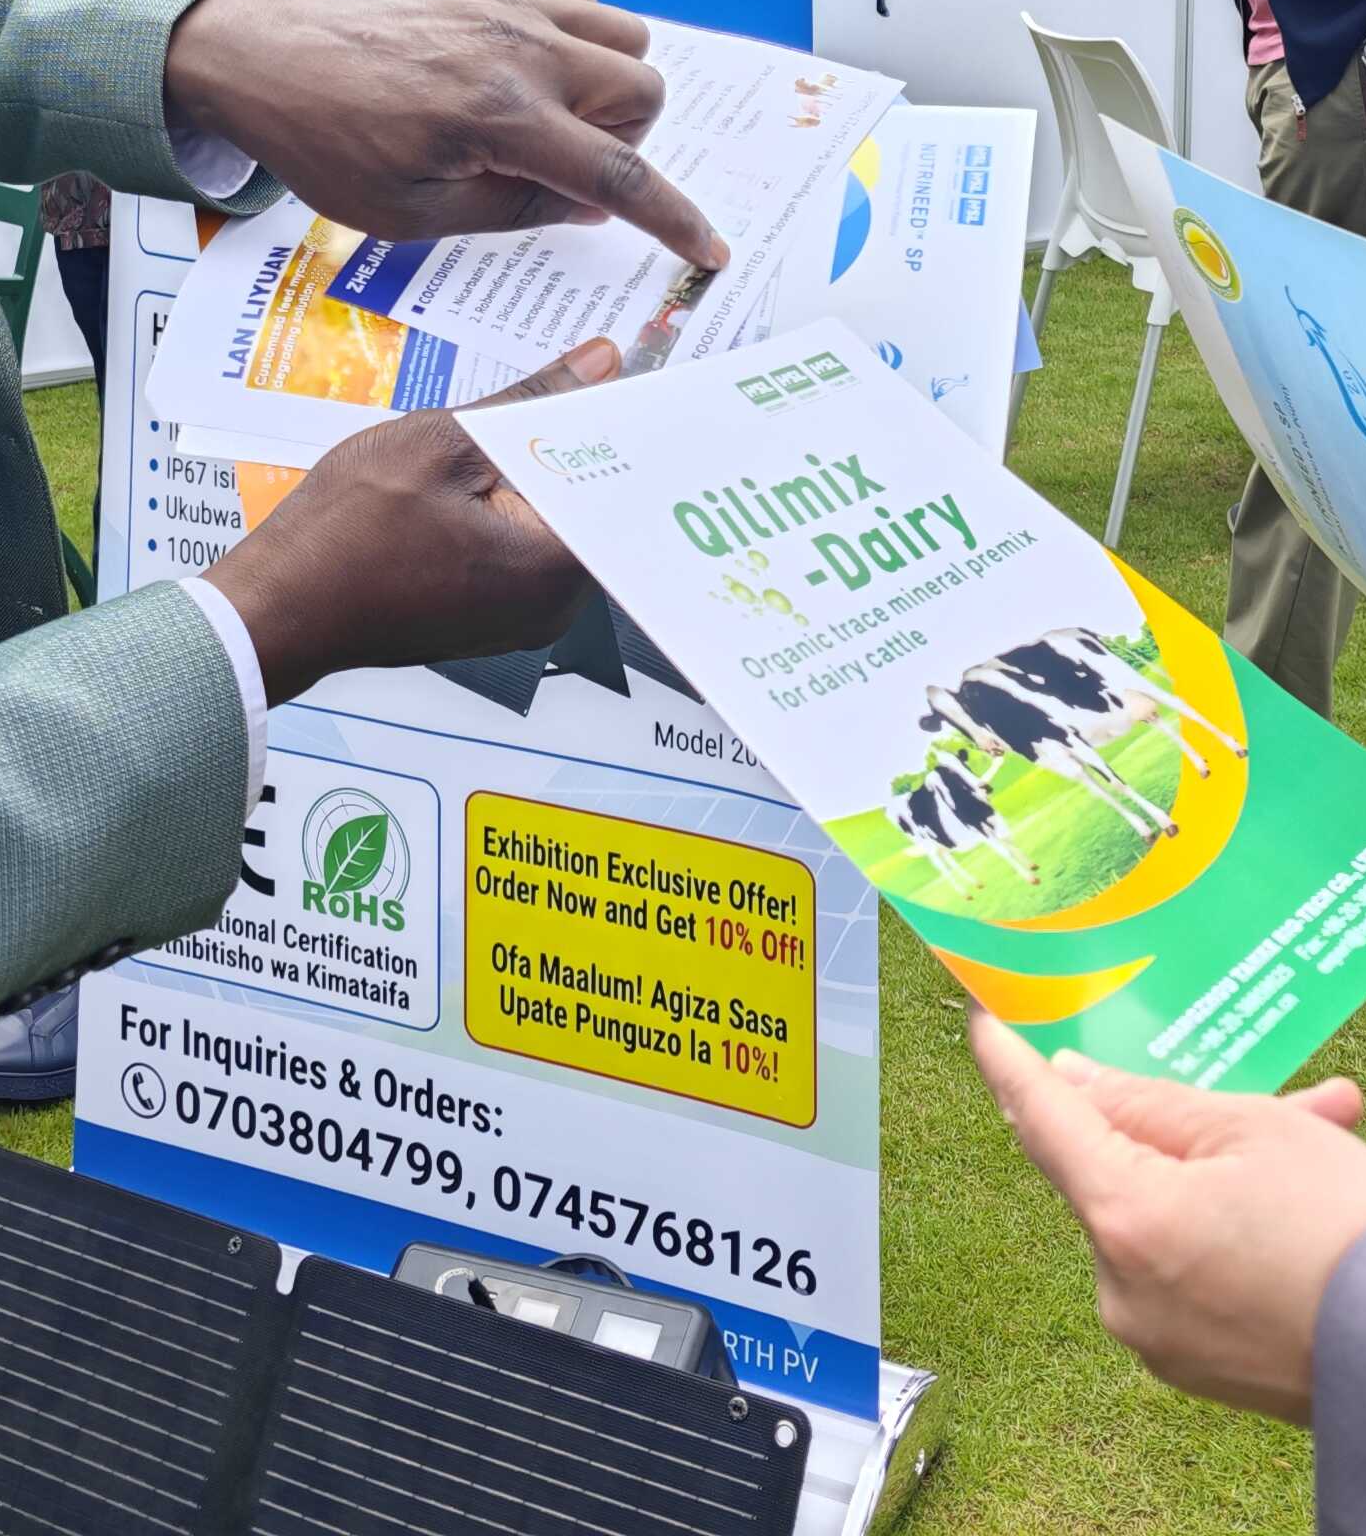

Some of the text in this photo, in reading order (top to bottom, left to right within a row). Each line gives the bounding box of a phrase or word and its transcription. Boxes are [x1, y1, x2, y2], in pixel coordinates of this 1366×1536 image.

[241, 246, 293, 320] LIYUAN
[345, 240, 395, 294] ZHEJIAN
[419, 244, 467, 305] COCCIDIOSTAT
[691, 288, 742, 360] FOODSTUFFS
[732, 249, 767, 297] LIMITED
[166, 455, 208, 489] IP67
[542, 436, 619, 473] Tanke
[165, 495, 242, 530] Ukubwa
[672, 453, 887, 558] Qilimix
[804, 493, 978, 592] -Dairy
[741, 526, 1039, 681] Organic trace mineral premix
[767, 626, 930, 713] for dairy cattle
[653, 720, 724, 760] Model
[302, 879, 406, 932] RoHS
[483, 825, 797, 926] Exhibition Exclusive Offer!
[283, 923, 418, 980] Certification
[475, 865, 805, 971] Order Now and Get 10% Off!
[153, 933, 411, 1011] thibitisho wa Kimataifa
[491, 942, 788, 1044] Ofa Maalum! Agiza Sasa
[120, 1003, 504, 1138] For Inquiries & Orders:
[499, 984, 779, 1084] Upate Punguzo la 10%!
[175, 1079, 818, 1297] 0703804799, 0745768126
[784, 1347, 820, 1384] PV
